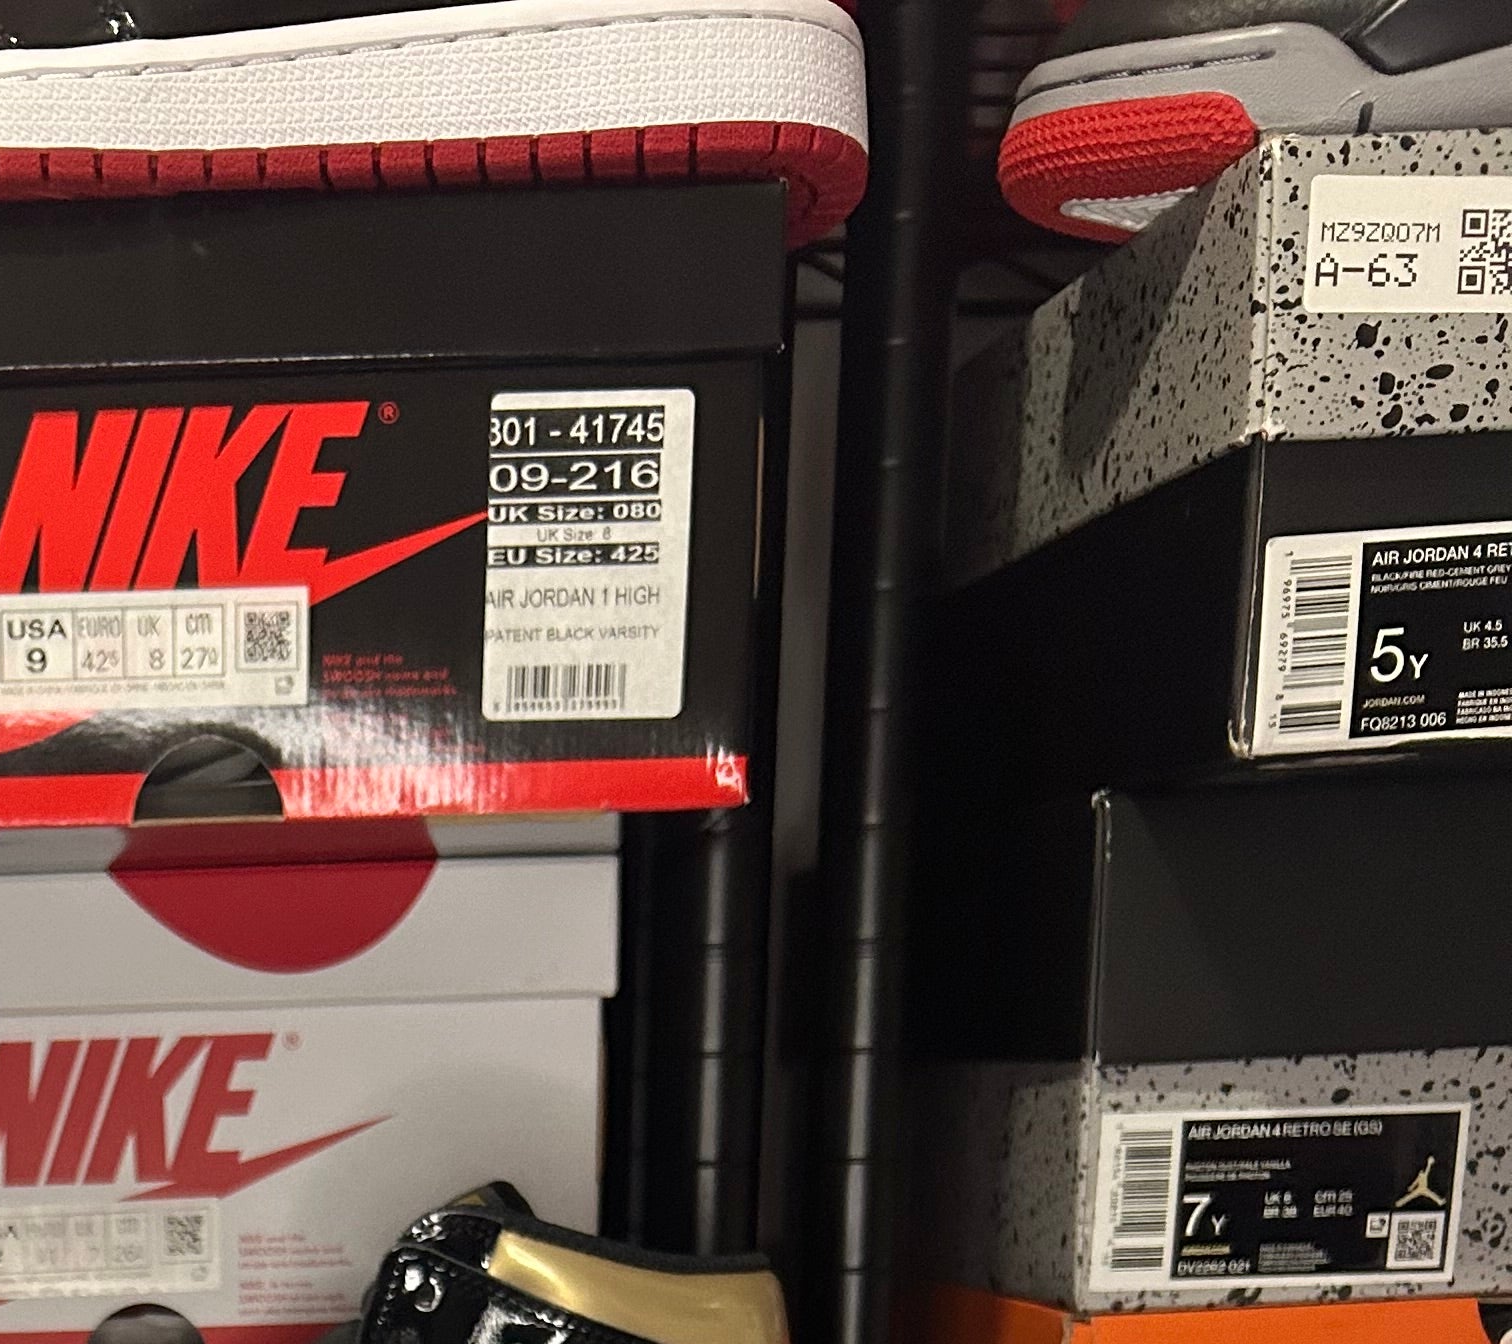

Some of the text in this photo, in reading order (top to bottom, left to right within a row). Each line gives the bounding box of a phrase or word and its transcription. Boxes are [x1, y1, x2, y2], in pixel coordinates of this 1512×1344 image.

[1315, 253, 1418, 287] A-63
[570, 413, 664, 445] 41745
[489, 460, 660, 492] 09-216
[489, 502, 662, 523] UK Size: 080
[488, 545, 660, 566] EU Size: 425
[1371, 551, 1400, 568] AIR
[1403, 545, 1470, 566] JORDAN
[1473, 544, 1482, 559] 4
[487, 585, 661, 610] AIR JORDAN 1 HIGH
[6, 618, 68, 641] USA
[546, 626, 593, 642] BLACK
[598, 624, 662, 641] VARSITY
[25, 647, 49, 674] 9
[1360, 712, 1447, 732] FQ8213 006
